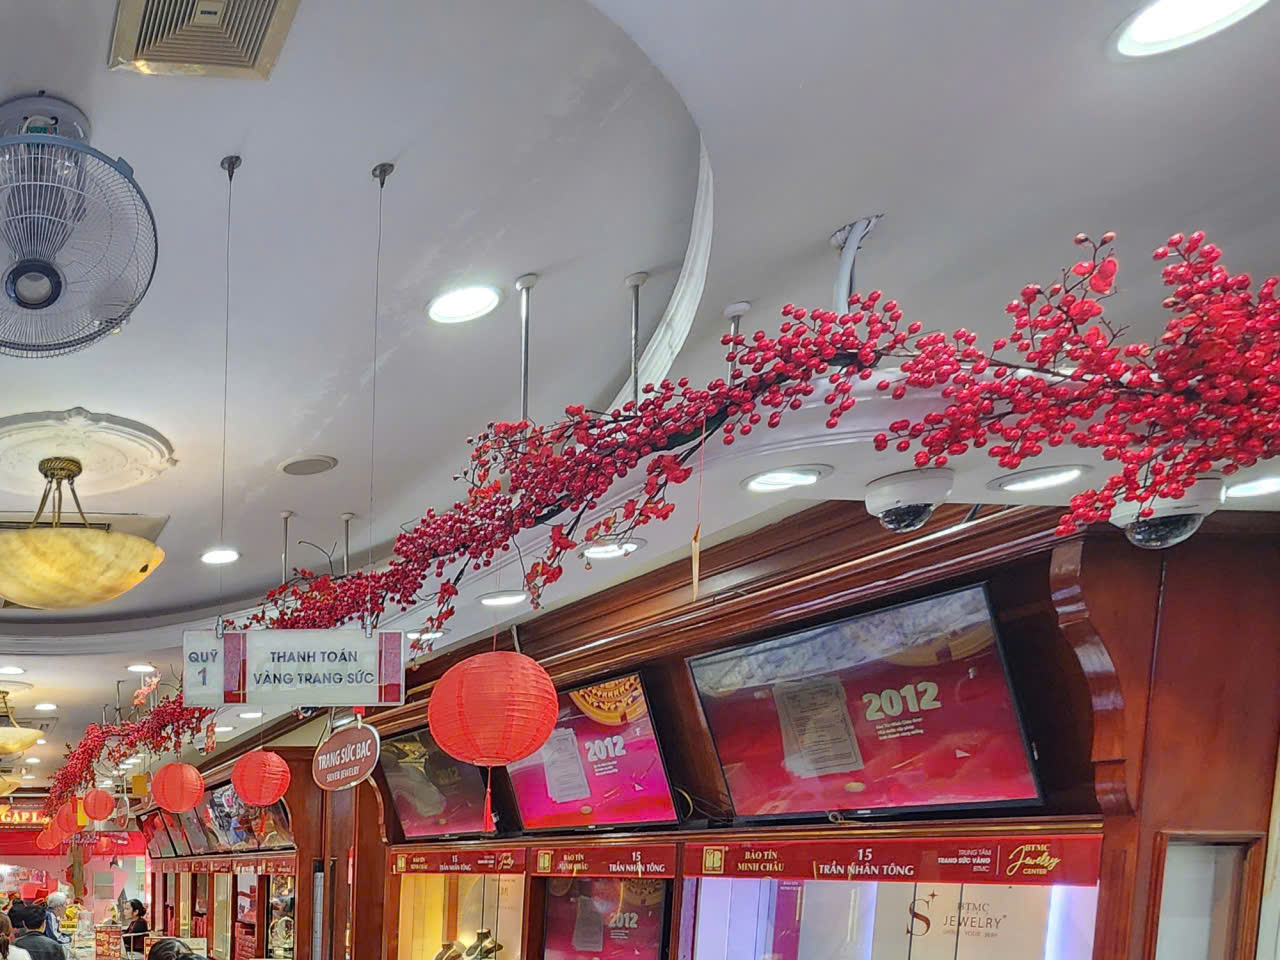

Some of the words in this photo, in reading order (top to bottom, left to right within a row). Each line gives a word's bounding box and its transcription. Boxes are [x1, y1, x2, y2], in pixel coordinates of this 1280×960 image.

[188, 649, 218, 665] QUỸ
[270, 651, 317, 663] THANH
[320, 648, 358, 663] TOÁN
[197, 666, 208, 686] 1
[253, 670, 294, 685] VÀNG
[298, 672, 343, 685] TRANG
[346, 668, 375, 685] SỨC
[862, 681, 942, 721] 2012
[318, 749, 341, 771] TRANG
[340, 743, 355, 764] SỨC
[355, 739, 372, 762] BẠC
[585, 735, 626, 762] 2012
[745, 849, 762, 860] BẢO
[763, 849, 778, 860] TÍN
[857, 848, 873, 861] 15
[1025, 844, 1050, 852] BTMC
[452, 855, 458, 863] 15
[632, 852, 641, 862] 15
[1006, 845, 1061, 876] Jewelry
[646, 861, 665, 873] TÔNG
[737, 862, 760, 872] MINH
[760, 860, 785, 872] CHÂU
[818, 860, 845, 875] TRẦN
[847, 861, 880, 875] NHÂN
[881, 862, 915, 876] TÔNG
[957, 902, 990, 912] BTMC
[607, 912, 639, 929] 2012
[943, 915, 1002, 929] JEWELRY
